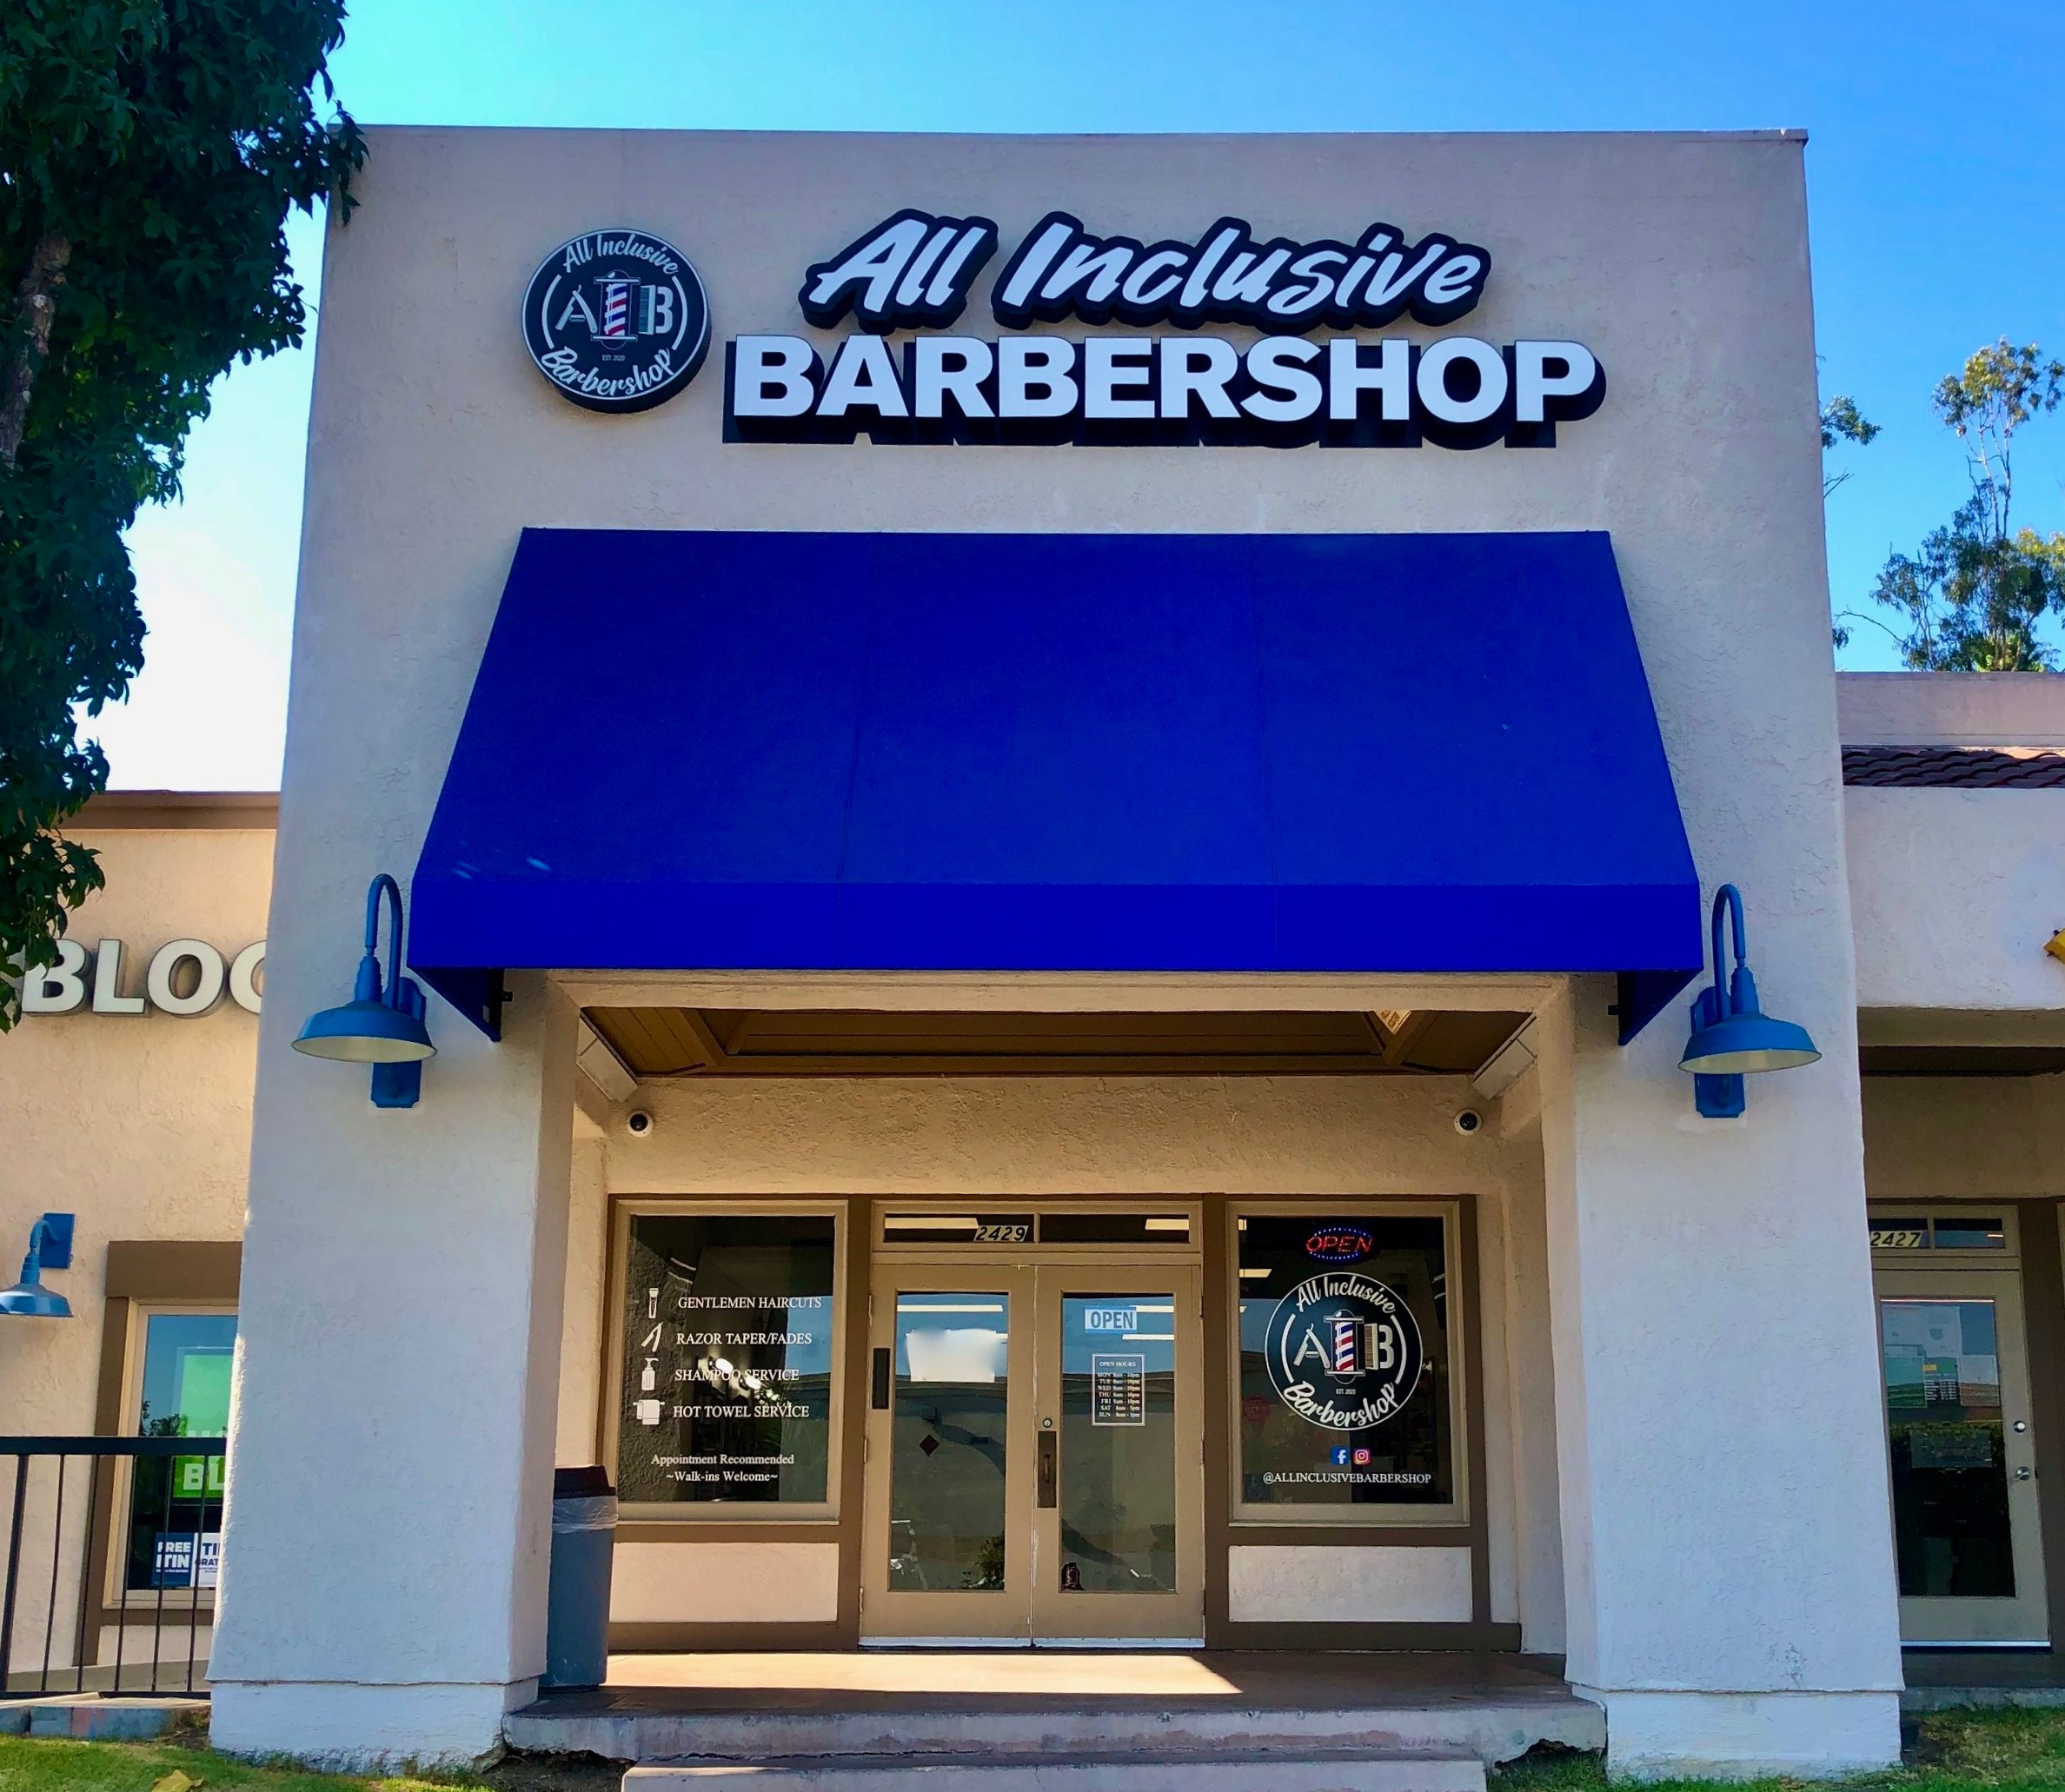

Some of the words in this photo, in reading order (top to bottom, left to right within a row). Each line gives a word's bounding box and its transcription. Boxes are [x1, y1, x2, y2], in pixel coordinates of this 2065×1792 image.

[562, 238, 593, 274] All
[597, 233, 679, 275] Inclusive
[808, 218, 987, 313] All
[1002, 222, 1481, 315] Inclusive
[541, 345, 674, 396] Barbershop
[734, 334, 1597, 424] BARBERSHOP
[975, 1226, 1027, 1242] 2429
[1870, 1231, 1922, 1248] 2427
[1305, 1235, 1374, 1253] OPEN
[1296, 1279, 1321, 1312] All
[1324, 1275, 1396, 1313] Inclusive
[678, 1297, 756, 1309] GENTLEMEN
[758, 1297, 821, 1309] HAIRCUTS
[1090, 1311, 1134, 1330] OPEN
[676, 1332, 723, 1344] RAZOR
[725, 1332, 813, 1345] TAPER/FADES
[674, 1369, 740, 1382] SHAMPOO
[744, 1369, 800, 1382] SERVICE
[673, 1405, 701, 1417] HOT
[704, 1405, 751, 1417] TOWEL
[754, 1405, 809, 1417] SERVICE
[1284, 1380, 1398, 1428] Barbershop
[651, 1454, 718, 1468] Appointment
[720, 1454, 794, 1464] Recommended
[1263, 1471, 1431, 1484] @ALLINCLUSIVEBARBERSHOP
[203, 1543, 220, 1556] TI
